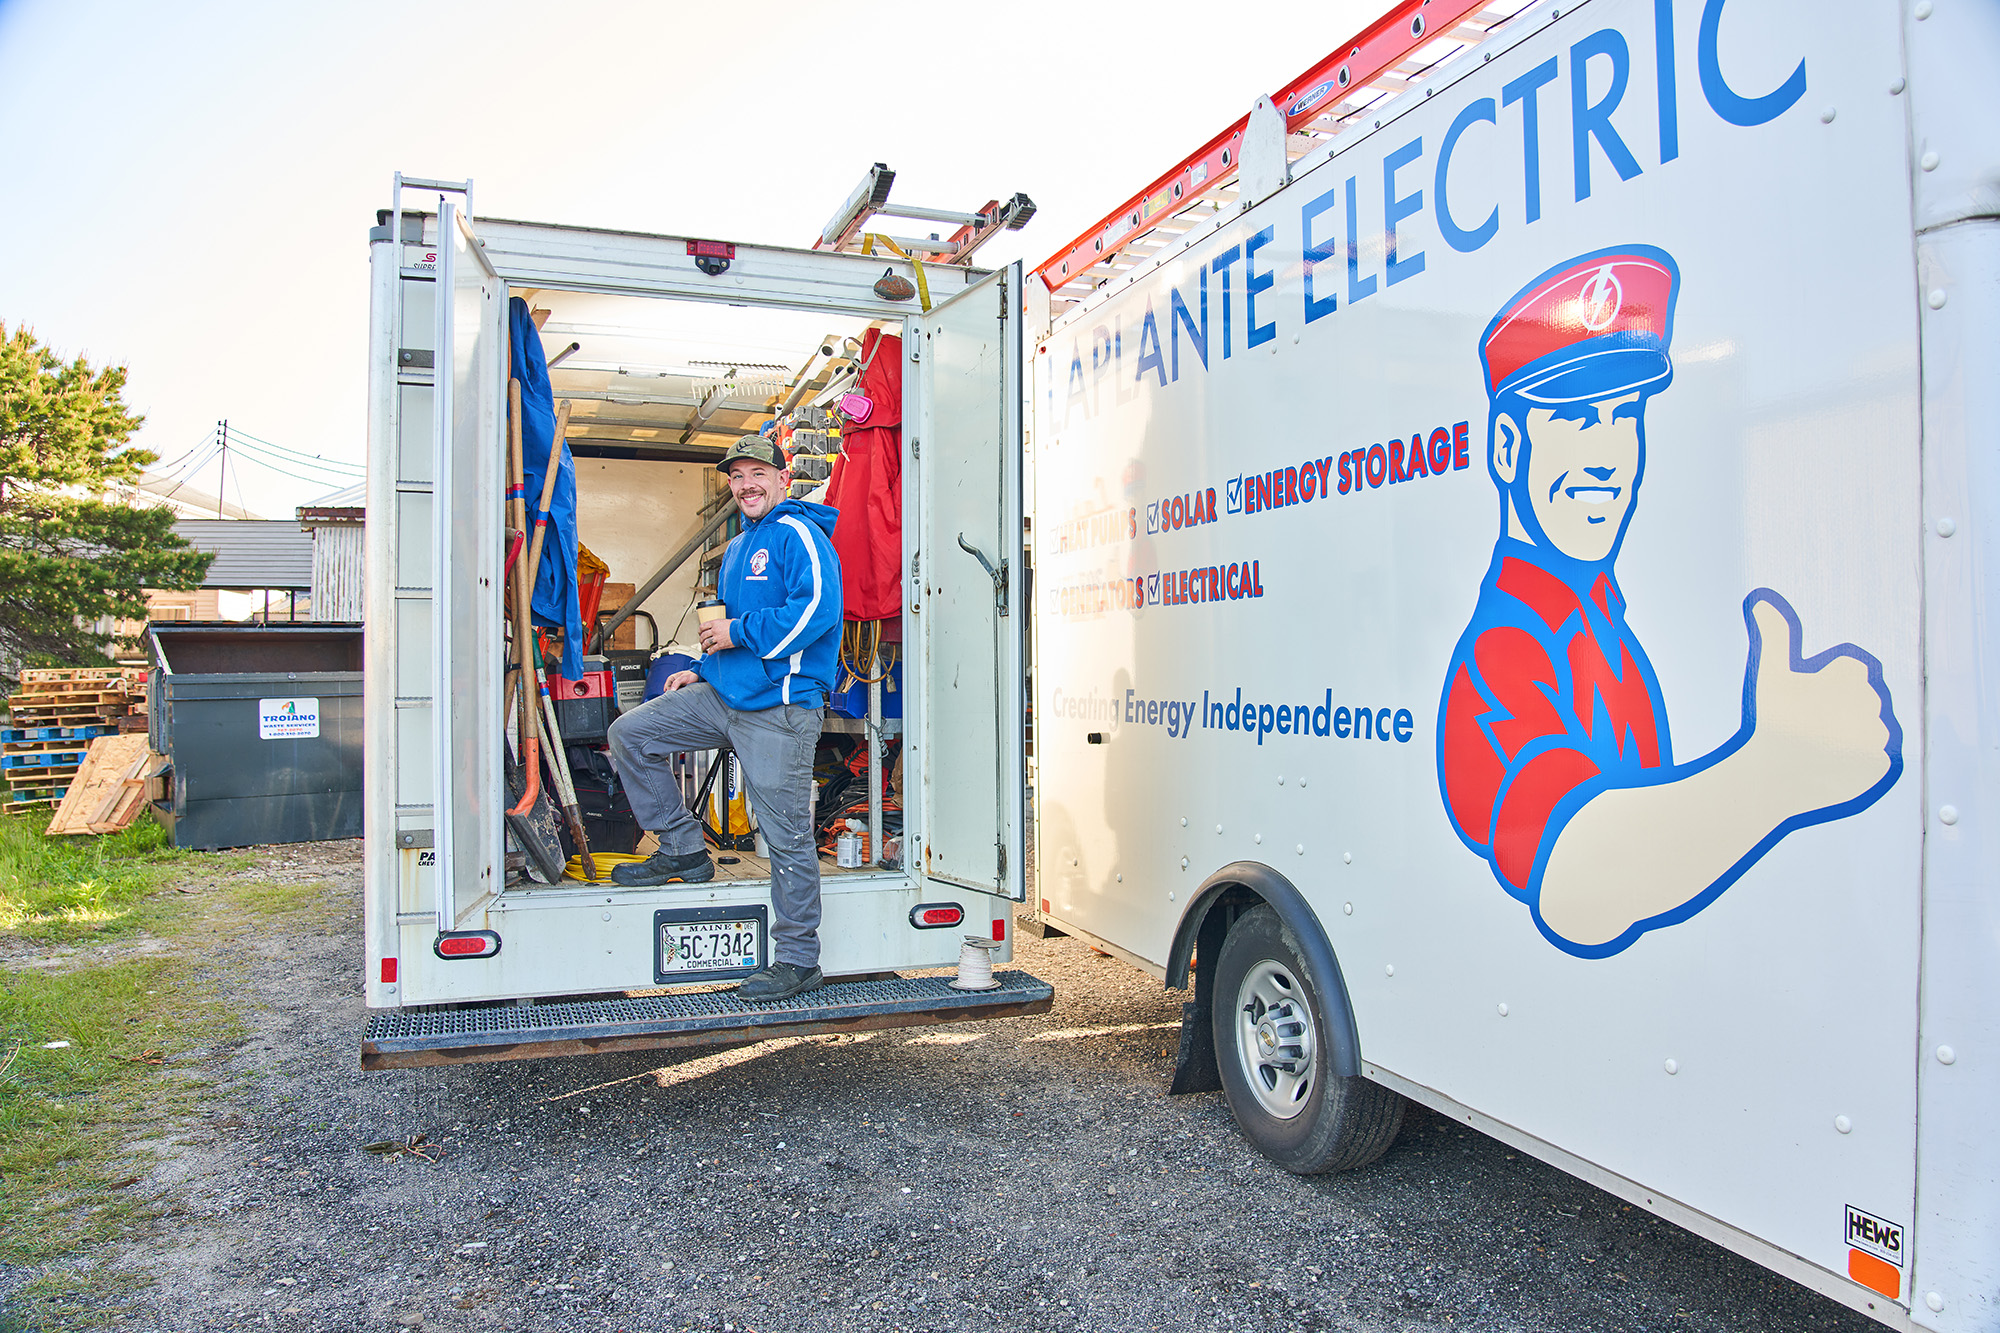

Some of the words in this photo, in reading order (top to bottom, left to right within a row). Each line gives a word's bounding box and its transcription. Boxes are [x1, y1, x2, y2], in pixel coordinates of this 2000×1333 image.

[1048, 224, 1276, 437] LAPLANTE
[1302, 0, 1806, 326] ELECTRIC
[1091, 507, 1136, 548] PUMPS
[1161, 487, 1217, 533] SOLAR
[1244, 456, 1332, 515] ENERGY
[1337, 420, 1469, 496] STORAGE
[1163, 559, 1264, 606] ELECTRICAL
[1053, 686, 1119, 732] Creating
[1125, 688, 1196, 739] Energy
[1202, 687, 1414, 745] Independence
[689, 923, 732, 932] MAINE
[687, 958, 735, 968] COMMERCIAL
[1849, 1211, 1900, 1251] HEWS
